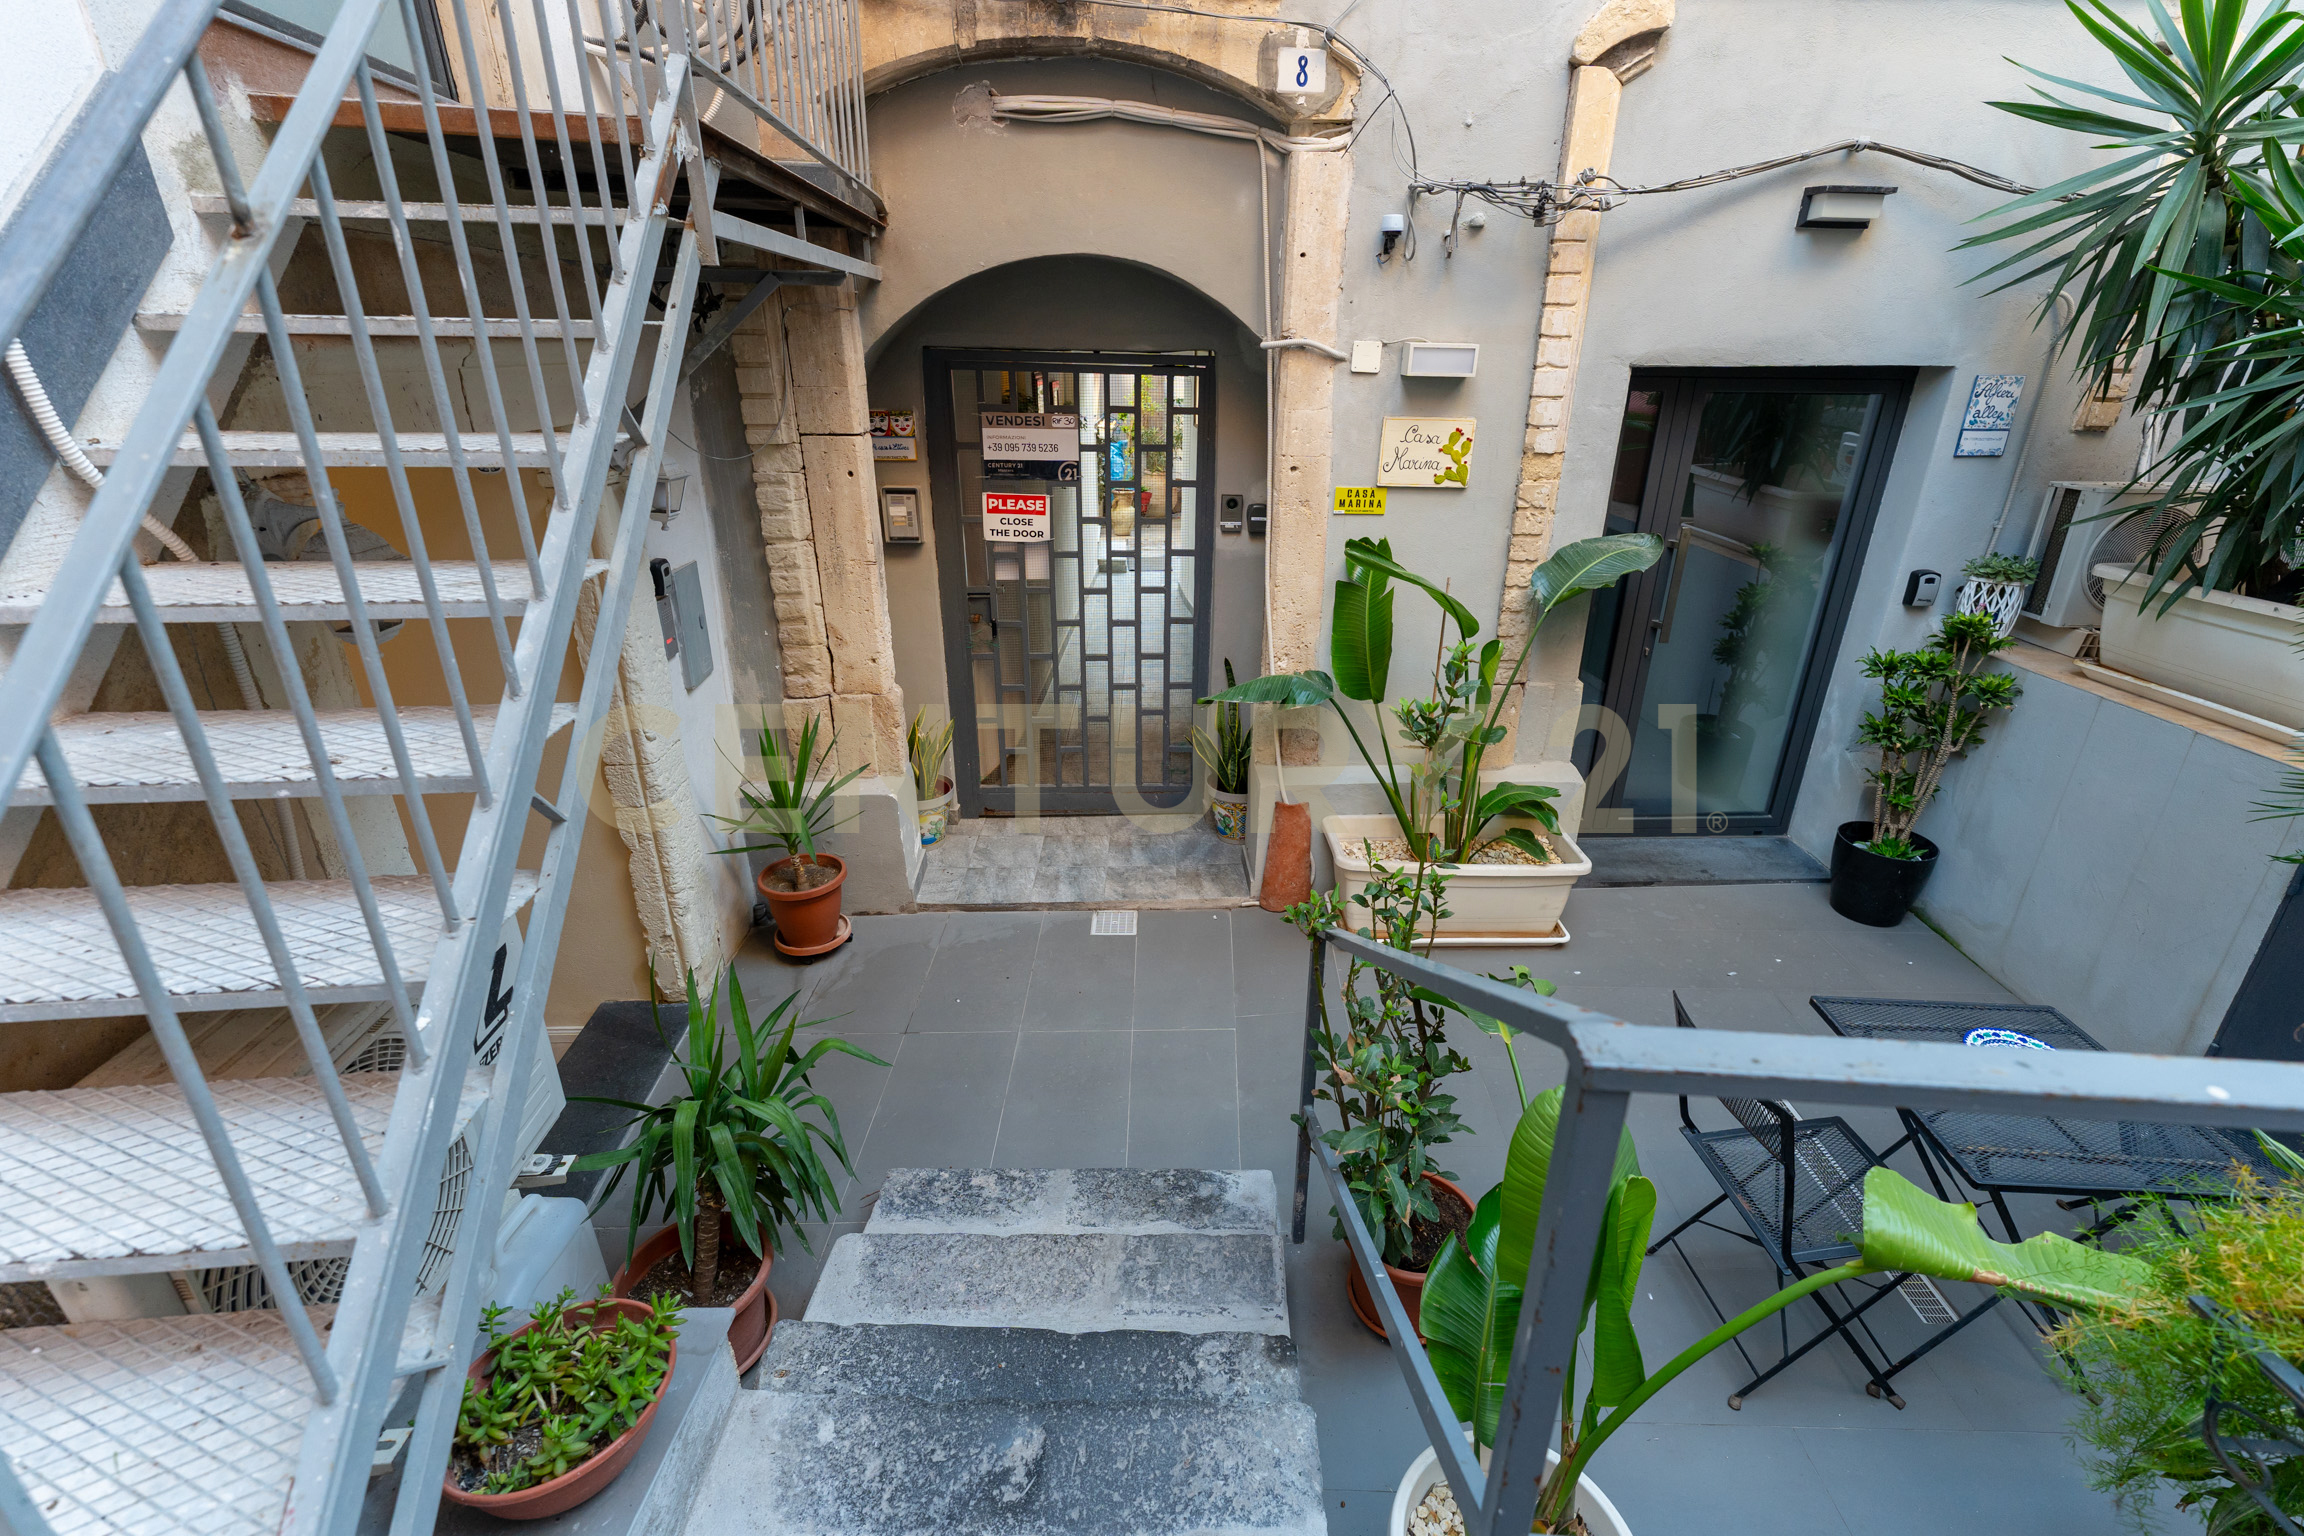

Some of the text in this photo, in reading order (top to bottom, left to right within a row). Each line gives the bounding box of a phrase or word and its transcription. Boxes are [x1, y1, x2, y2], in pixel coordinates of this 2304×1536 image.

[1296, 55, 1308, 87] 8
[1972, 405, 2003, 423] alley
[986, 415, 1045, 427] VENDESI
[1400, 424, 1440, 445] Casa
[987, 442, 1059, 453] +39 095 739 5236
[1382, 446, 1440, 473] Marina
[1347, 489, 1375, 498] CASA
[988, 498, 1045, 511] PLEASE
[1339, 499, 1382, 508] MARINA
[1000, 517, 1034, 526] CLOSE
[989, 528, 1044, 538] THE DOOR
